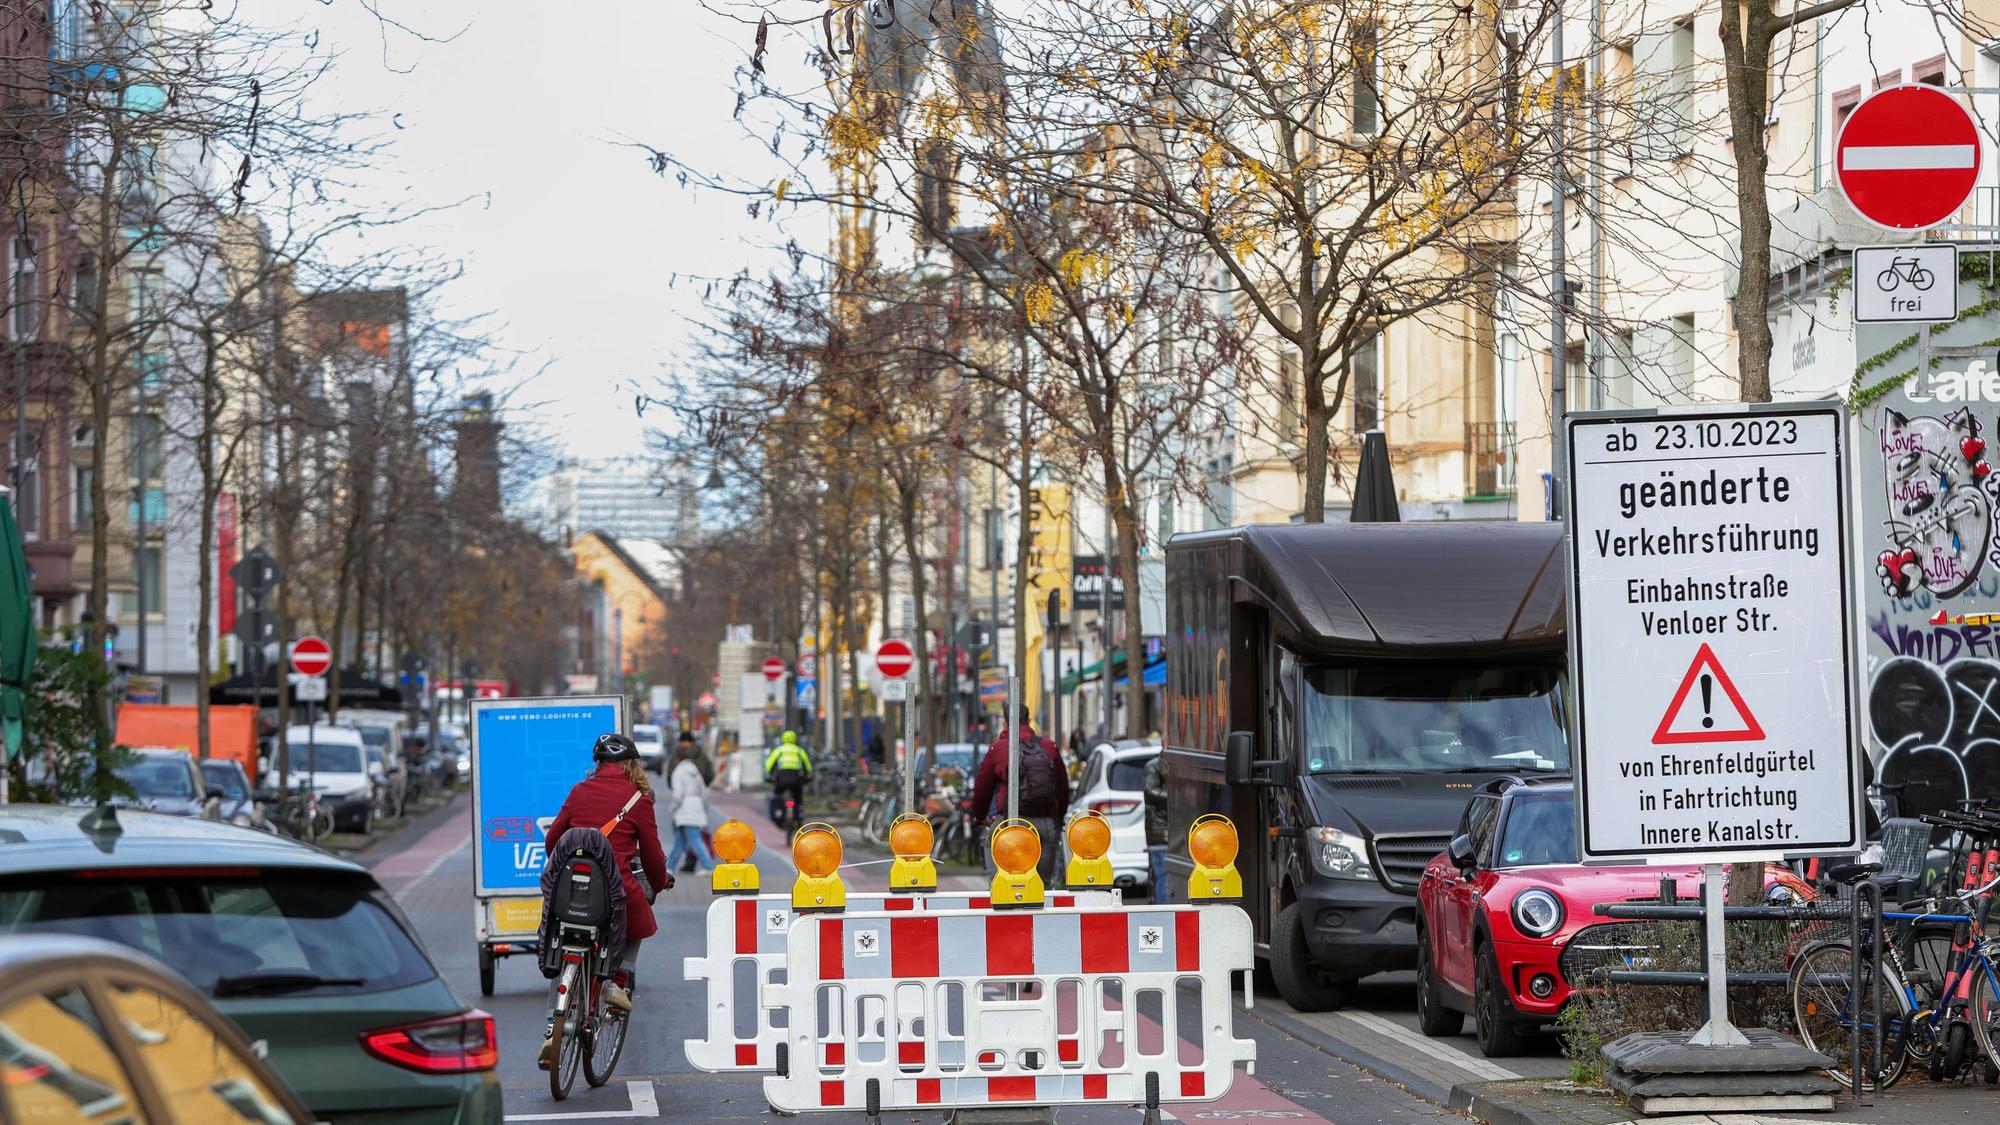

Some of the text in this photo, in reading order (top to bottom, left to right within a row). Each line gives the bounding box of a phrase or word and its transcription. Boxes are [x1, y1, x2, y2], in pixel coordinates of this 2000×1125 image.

[1891, 296, 1921, 312] frei
[1605, 419, 1797, 451] ab 23.10.2023
[1619, 467, 1790, 519] geänderte
[1595, 523, 1819, 557] Verkehrsführung
[1627, 573, 1788, 603] Einbahnstraße
[1642, 607, 1777, 636] Venloer Str.
[1620, 749, 1816, 778] von Ehrenfeldgürtel
[1640, 786, 1798, 811] in Fahrtrichtung
[1641, 818, 1799, 845] Innere Kanalstr.
[1879, 1061, 1898, 1078] AXA
